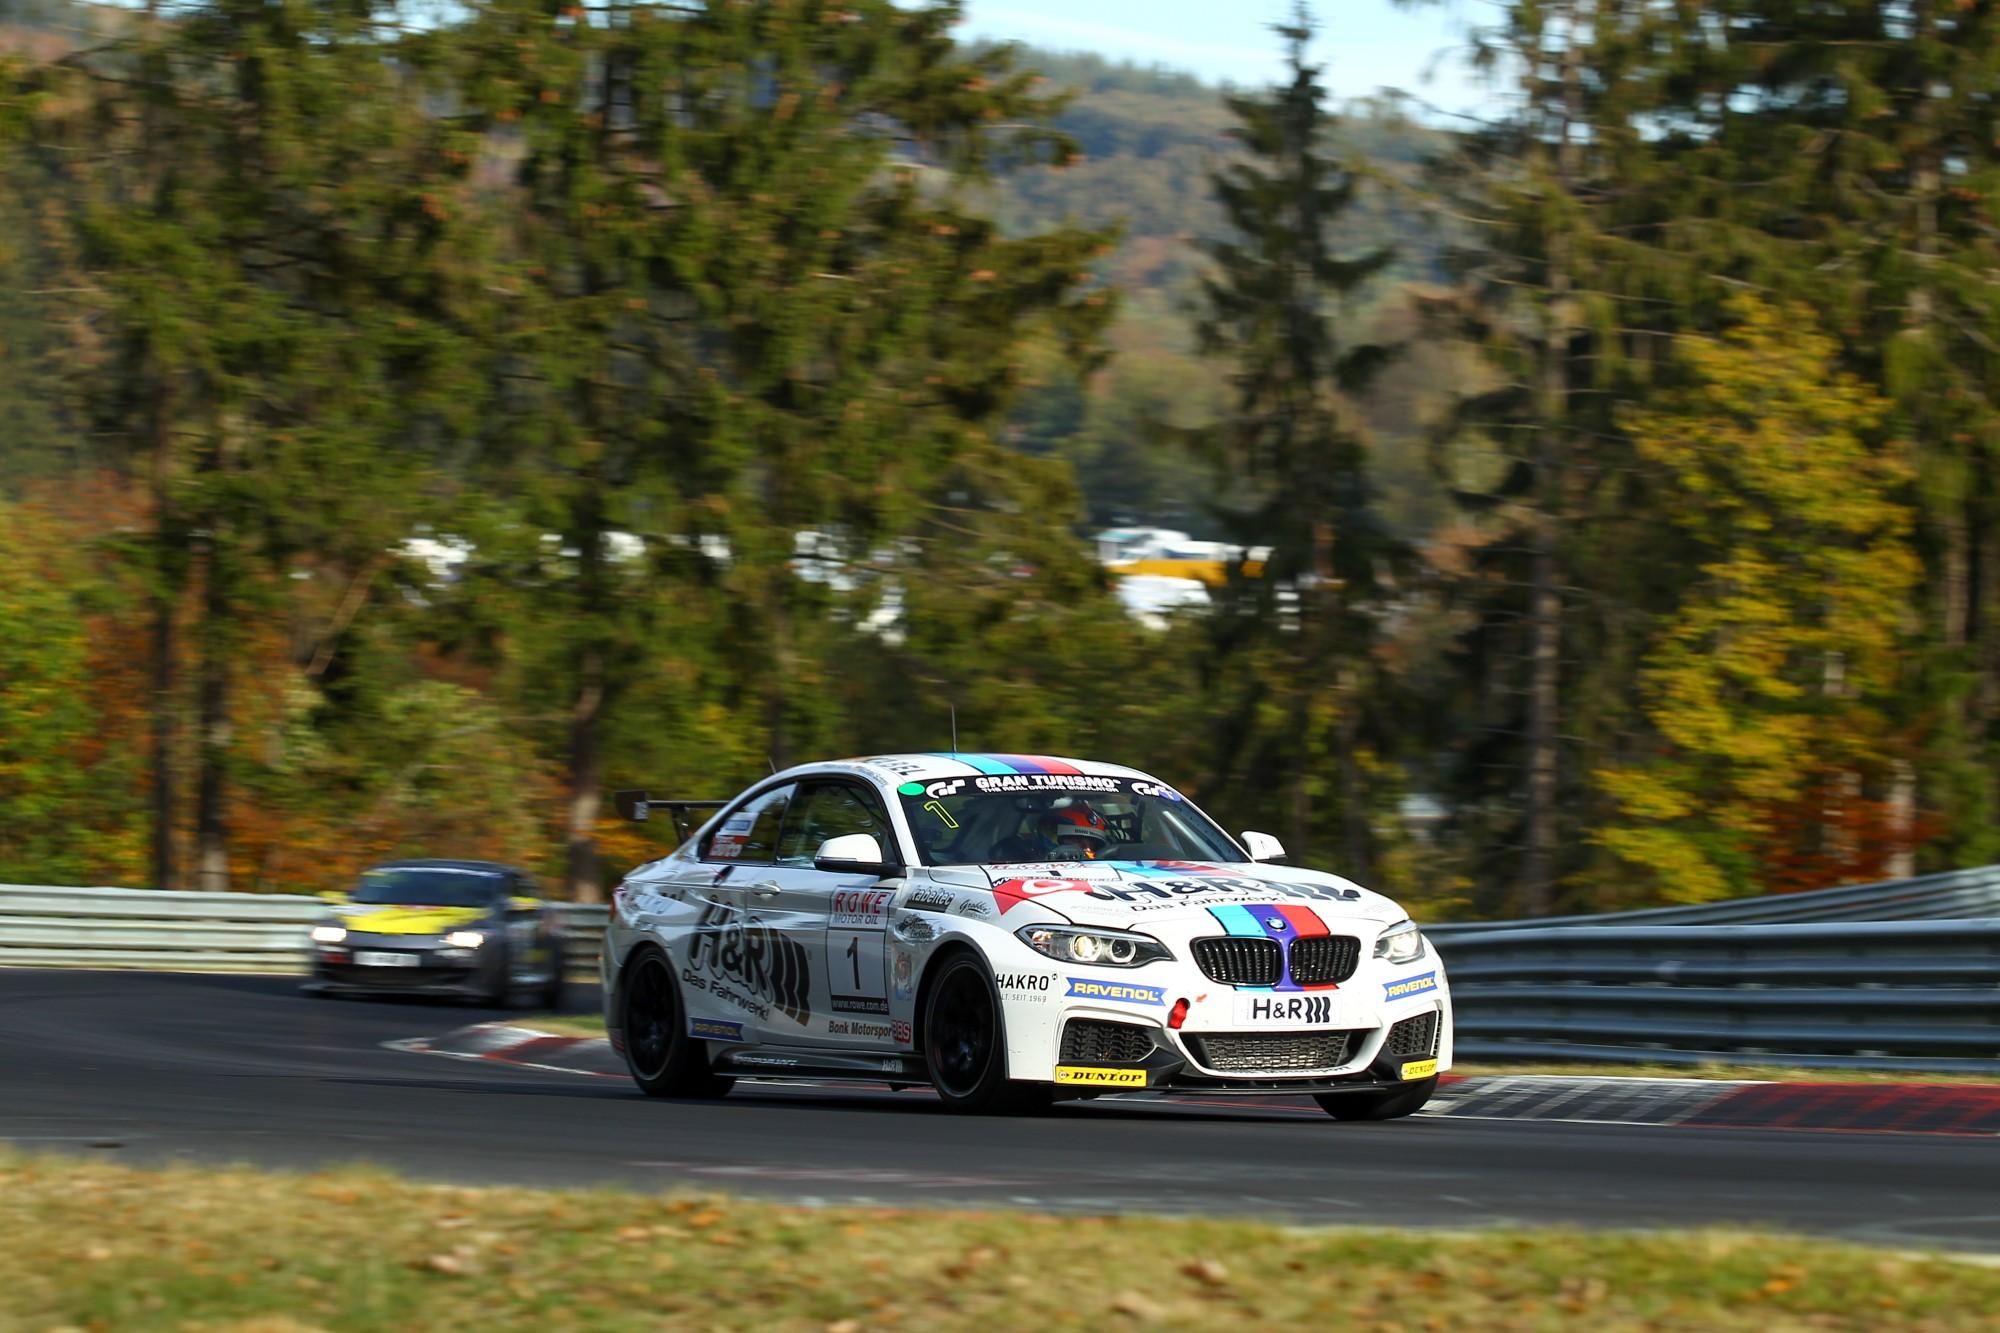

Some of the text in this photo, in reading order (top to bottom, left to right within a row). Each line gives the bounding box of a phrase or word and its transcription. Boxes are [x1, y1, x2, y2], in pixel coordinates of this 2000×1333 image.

[975, 775, 1115, 788] GRAN TURISMO
[1067, 785, 1119, 793] SIMULATOR
[924, 801, 959, 829] 1
[835, 892, 888, 914] ROWE
[1130, 904, 1173, 913] Das
[833, 914, 879, 925] MOTOR OIL
[847, 936, 861, 990] 1
[996, 973, 1049, 991] HAKRO
[1387, 977, 1436, 997] RAVENOL
[682, 968, 771, 1021] Das Fahrwerk!
[1029, 995, 1047, 1003] 1969
[1074, 982, 1159, 1001] RAVENOL
[829, 1021, 892, 1039] Bonk Motorspor
[1071, 1071, 1143, 1083] DUNLOP
